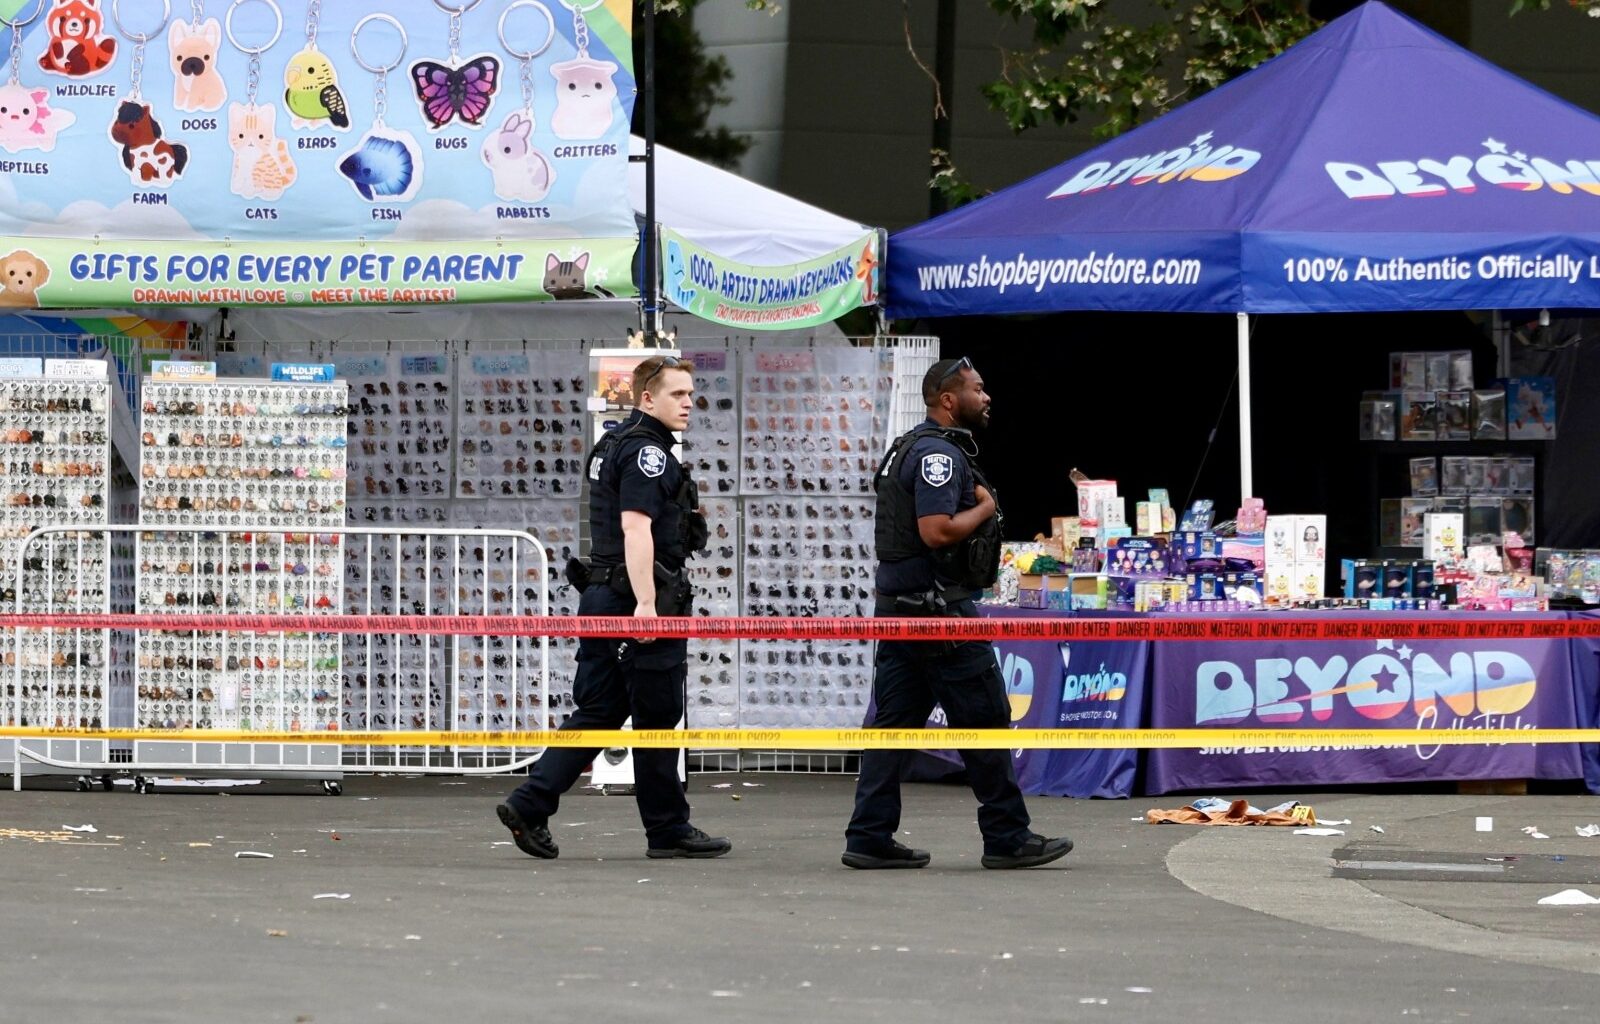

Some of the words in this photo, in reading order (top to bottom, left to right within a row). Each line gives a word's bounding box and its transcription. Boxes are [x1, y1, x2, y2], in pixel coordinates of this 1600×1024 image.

[56, 85, 116, 97] WILDLIFE
[181, 118, 218, 132] DOGS
[298, 136, 337, 150] BIRDS
[435, 137, 468, 151] BUGS
[554, 144, 618, 158] CRITTERS
[1325, 154, 1600, 200] BEYON
[133, 192, 168, 205] FARM
[245, 207, 278, 220] CATS
[372, 208, 402, 222] FISH
[497, 206, 551, 219] RABBITS
[70, 252, 158, 282] GIFTS
[166, 254, 228, 282] FOR
[237, 254, 331, 283] EVERY
[340, 253, 395, 283] PET
[403, 253, 524, 282] PARENT
[918, 251, 1201, 294] www.shopbeyondstore.com
[1283, 257, 1348, 282] 100%
[1354, 256, 1472, 281] Authentic
[1479, 254, 1584, 284] Officially
[690, 254, 719, 291] 1000+
[722, 270, 758, 303] ARTIST
[760, 277, 798, 304] DRAWN
[799, 256, 854, 298] KEYCHAINS
[133, 288, 194, 303] DRAWN
[198, 289, 242, 304] WITH
[245, 288, 286, 304] LOVE
[311, 288, 354, 303] MEET
[358, 288, 392, 303] THE
[395, 287, 456, 303] ARTIST!
[163, 365, 205, 374] WILDLIFE
[282, 367, 324, 375] WILDLIFE
[645, 448, 664, 459] SEATTLE
[927, 456, 948, 464] SEATTLE
[643, 464, 660, 474] POLICE
[152, 617, 198, 627] MATERIAL
[201, 617, 213, 627] DO
[215, 617, 232, 627] NOT
[235, 617, 264, 627] ENTER
[270, 618, 305, 628] DANGER
[309, 619, 363, 629] HAZARDOUS
[367, 619, 413, 629] MATERIAL
[416, 620, 428, 630] DO
[430, 620, 447, 630] NOT
[449, 620, 477, 631] ENTER
[484, 620, 518, 632] DANGER
[523, 621, 576, 633] HAZARDOUS
[580, 621, 625, 633] MATERIAL
[628, 621, 640, 633] DO
[642, 621, 659, 633] NOT
[662, 621, 690, 633] ENTER
[696, 621, 730, 634] DANGER
[734, 621, 787, 634] HAZARDOUS
[792, 622, 834, 635] MATERIAL
[840, 622, 851, 635] DO
[853, 622, 870, 635] NOT
[873, 622, 900, 635] ENTER
[907, 622, 941, 635] DANGER
[945, 622, 997, 636] HAZARDOUS
[1002, 622, 1044, 636] MATERIAL
[1049, 622, 1060, 636] DO
[1062, 622, 1079, 636] NOT
[1082, 623, 1110, 636] ENTER
[1116, 623, 1150, 636] DANGER
[1154, 623, 1206, 636] HAZARDOUS
[1210, 623, 1253, 636] MATERIAL
[1258, 623, 1270, 636] DO
[1271, 623, 1288, 636] NOT
[1290, 623, 1318, 636] ENTER
[1324, 623, 1358, 636] DANGER
[1361, 623, 1414, 636] HAZARDOUS
[1418, 623, 1460, 636] MATERIAL
[1464, 623, 1476, 636] DO
[1479, 623, 1493, 636] NOT
[1496, 623, 1524, 636] ENTER
[1531, 623, 1565, 636] DANGER
[1062, 673, 1127, 702] BEYOND
[1195, 651, 1537, 726] BEYOND
